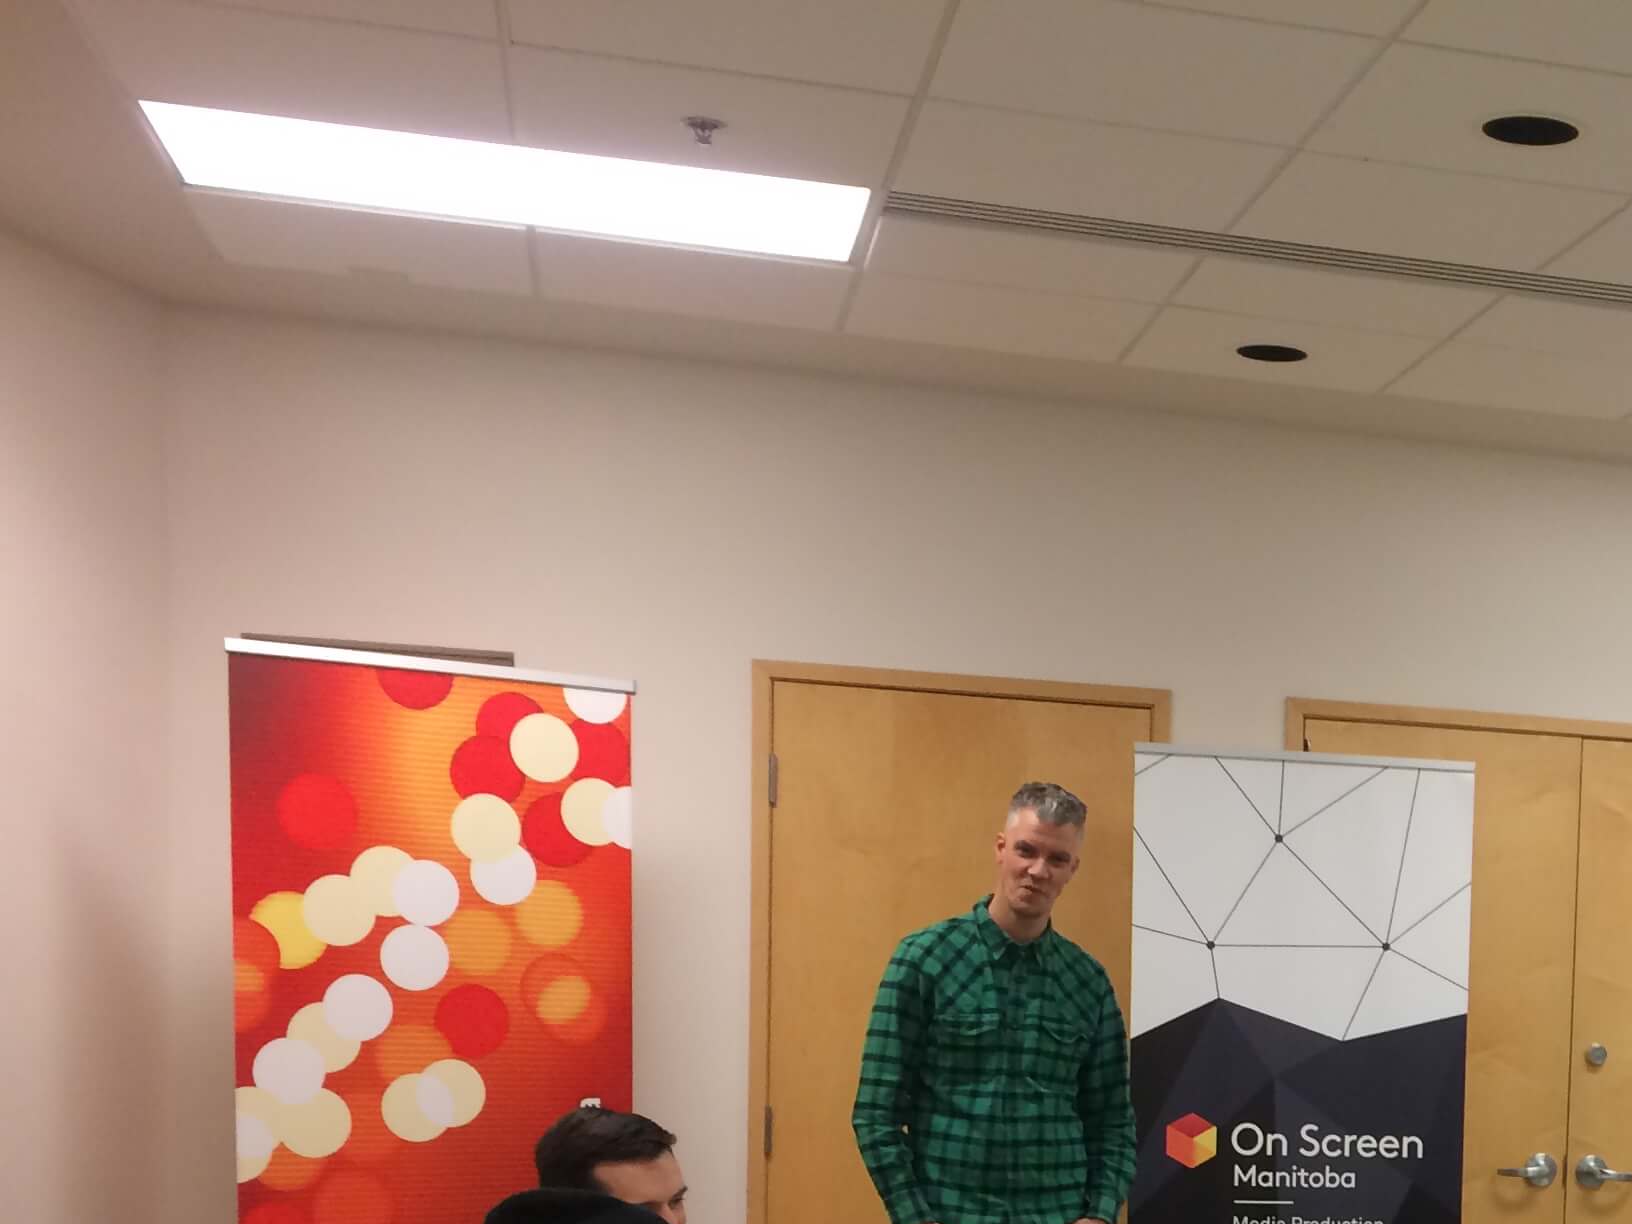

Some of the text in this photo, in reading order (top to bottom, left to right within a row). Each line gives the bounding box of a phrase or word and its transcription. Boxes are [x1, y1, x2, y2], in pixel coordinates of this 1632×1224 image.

[1231, 1122, 1424, 1159] On Screen
[1233, 1164, 1356, 1189] Manitoba
